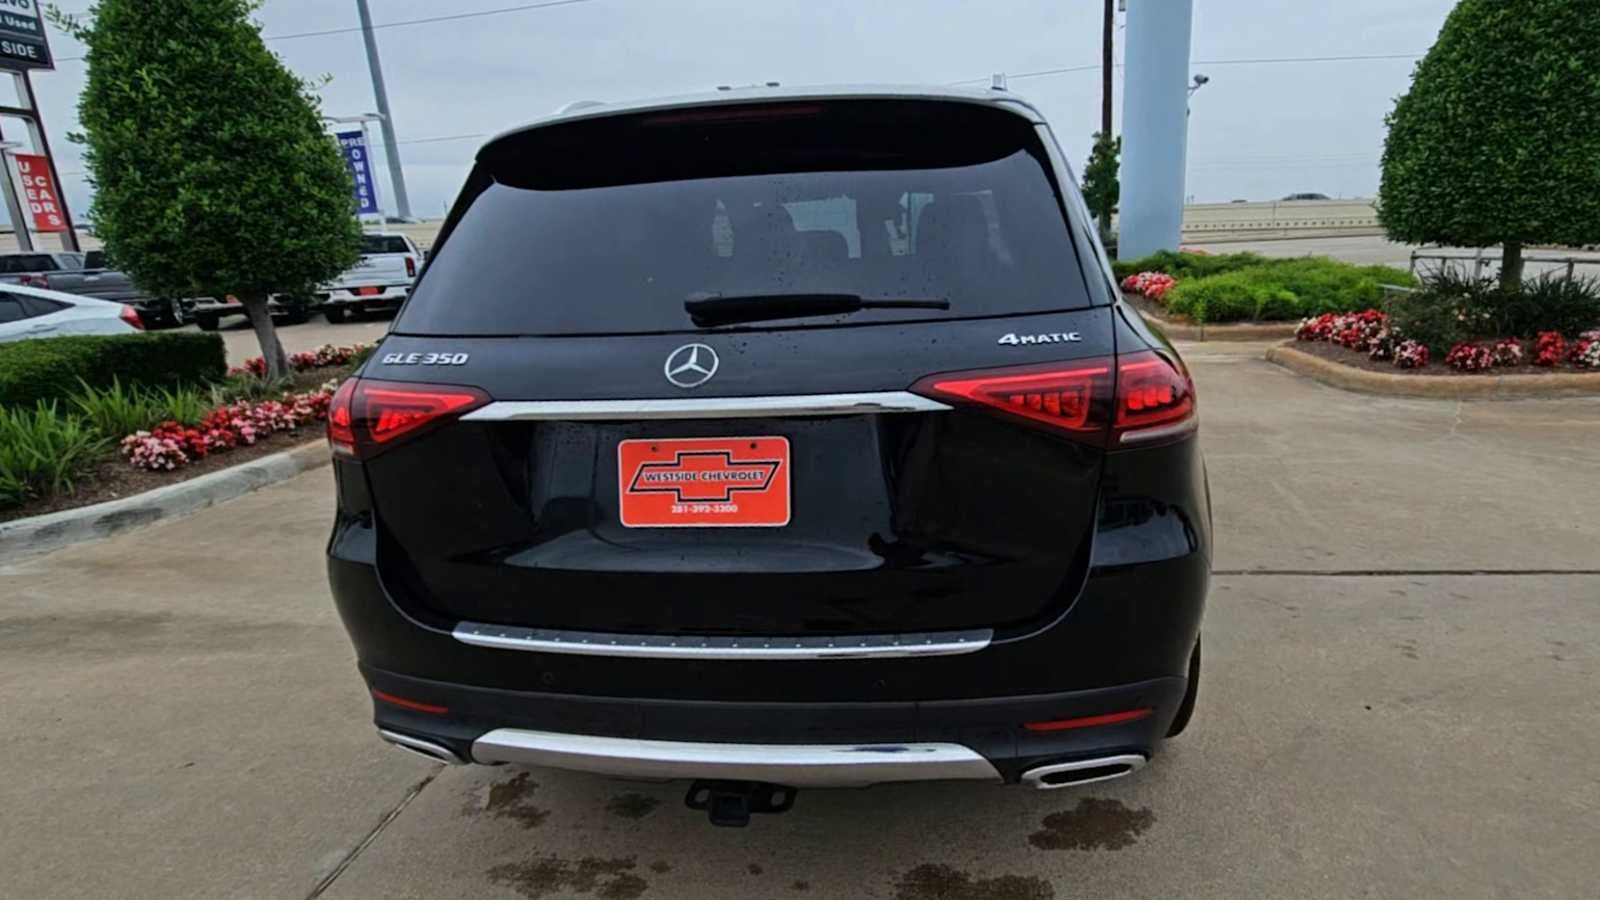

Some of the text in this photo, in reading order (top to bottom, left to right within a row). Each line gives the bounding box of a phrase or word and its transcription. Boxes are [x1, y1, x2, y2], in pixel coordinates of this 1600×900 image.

[4, 15, 36, 30] Used
[1, 41, 38, 58] SIDE
[18, 161, 61, 226] USED CARS
[997, 332, 1081, 345] 4MATIC
[382, 352, 470, 365] GLE 350
[644, 470, 766, 481] WESTSIDE CHEVROLET
